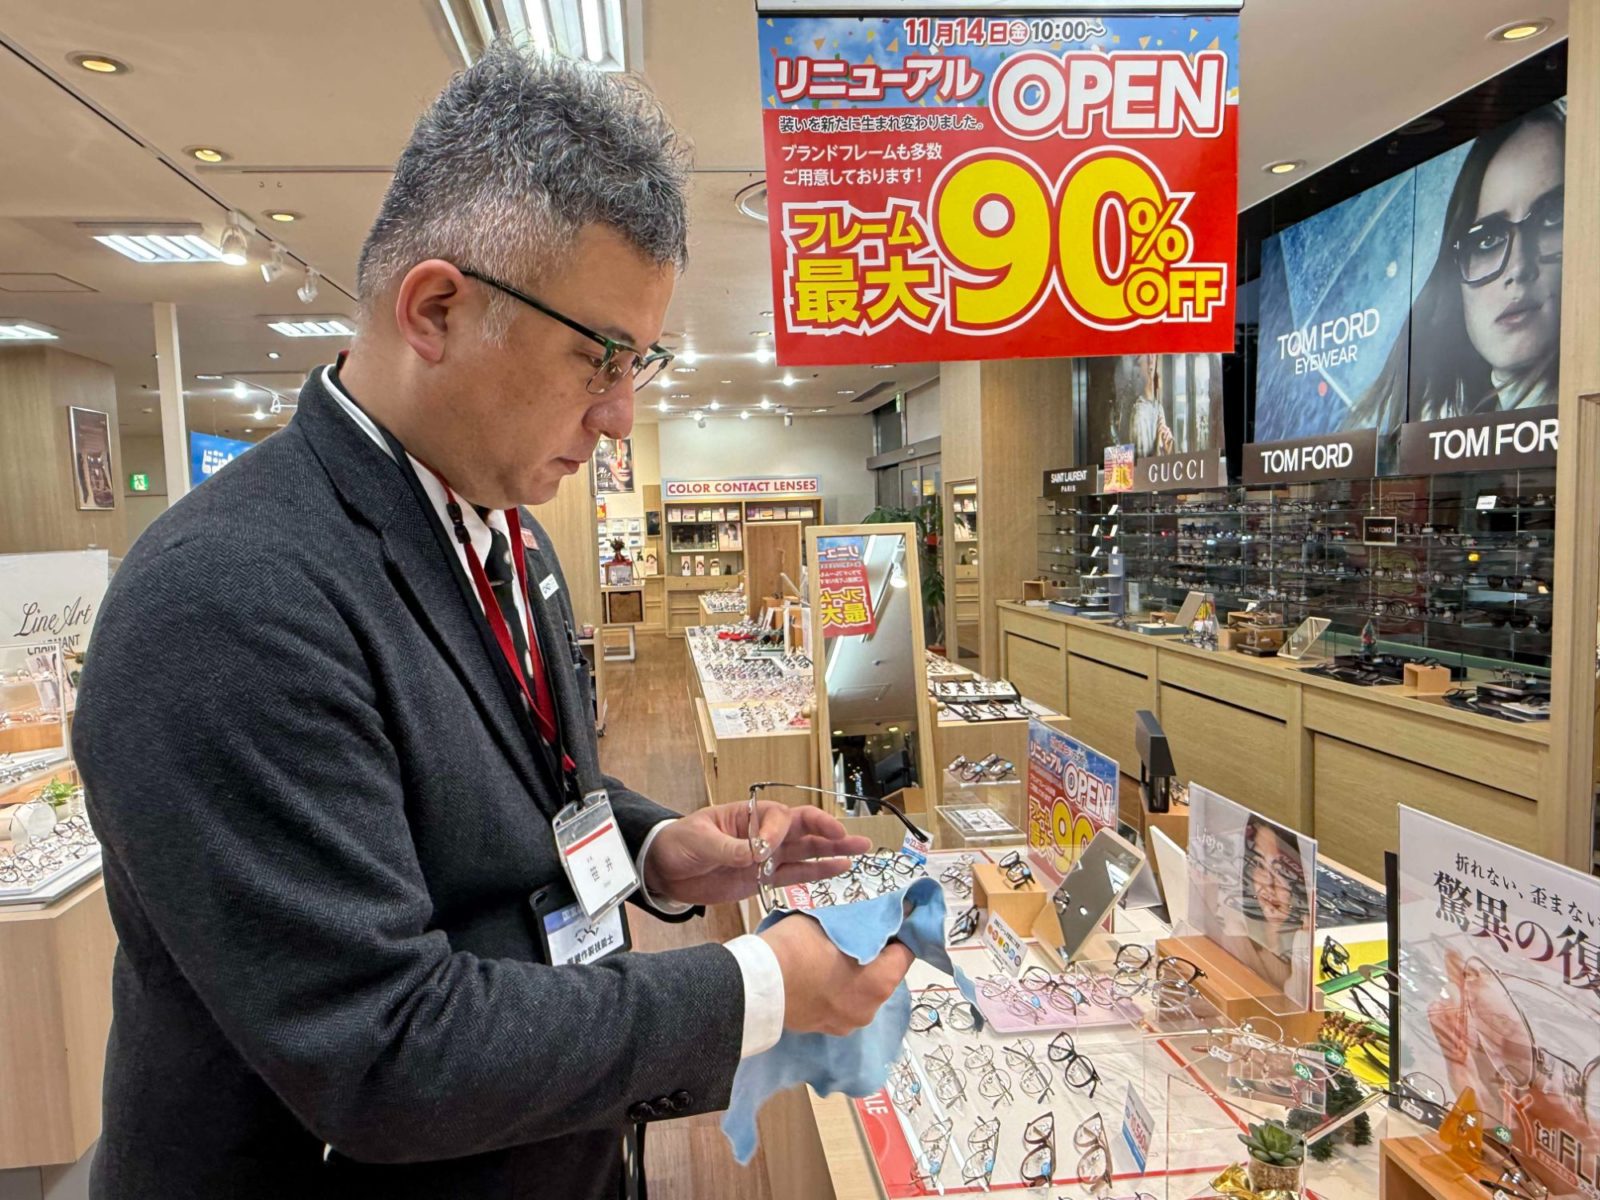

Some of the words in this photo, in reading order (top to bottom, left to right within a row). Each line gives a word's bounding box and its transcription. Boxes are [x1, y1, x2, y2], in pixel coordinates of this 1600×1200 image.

[778, 57, 981, 99] リニューアル
[995, 54, 1223, 136] OPEN
[779, 115, 984, 133] 装いを新たに生まれ変わりました。
[781, 142, 942, 162] ブランドフレームも多数
[783, 168, 922, 186] ご用意しております！
[795, 210, 920, 249] フレーム
[796, 257, 934, 324] 最大
[1277, 325, 1317, 360] TOM
[1321, 308, 1380, 349] FORD
[1295, 345, 1358, 374] EYEWEAR
[1260, 448, 1298, 474] TOM
[1301, 442, 1353, 471] FORD
[1429, 426, 1490, 461] TOM
[1050, 472, 1065, 484] SAINT
[1064, 469, 1088, 482] LAURENT
[1148, 458, 1205, 483] GUCCI
[668, 483, 711, 494] COLOR
[714, 482, 770, 493] CONTACT
[774, 480, 816, 491] LENSES
[1060, 485, 1076, 493] PARIS
[13, 601, 59, 637] Line
[1064, 760, 1113, 825] OPEN
